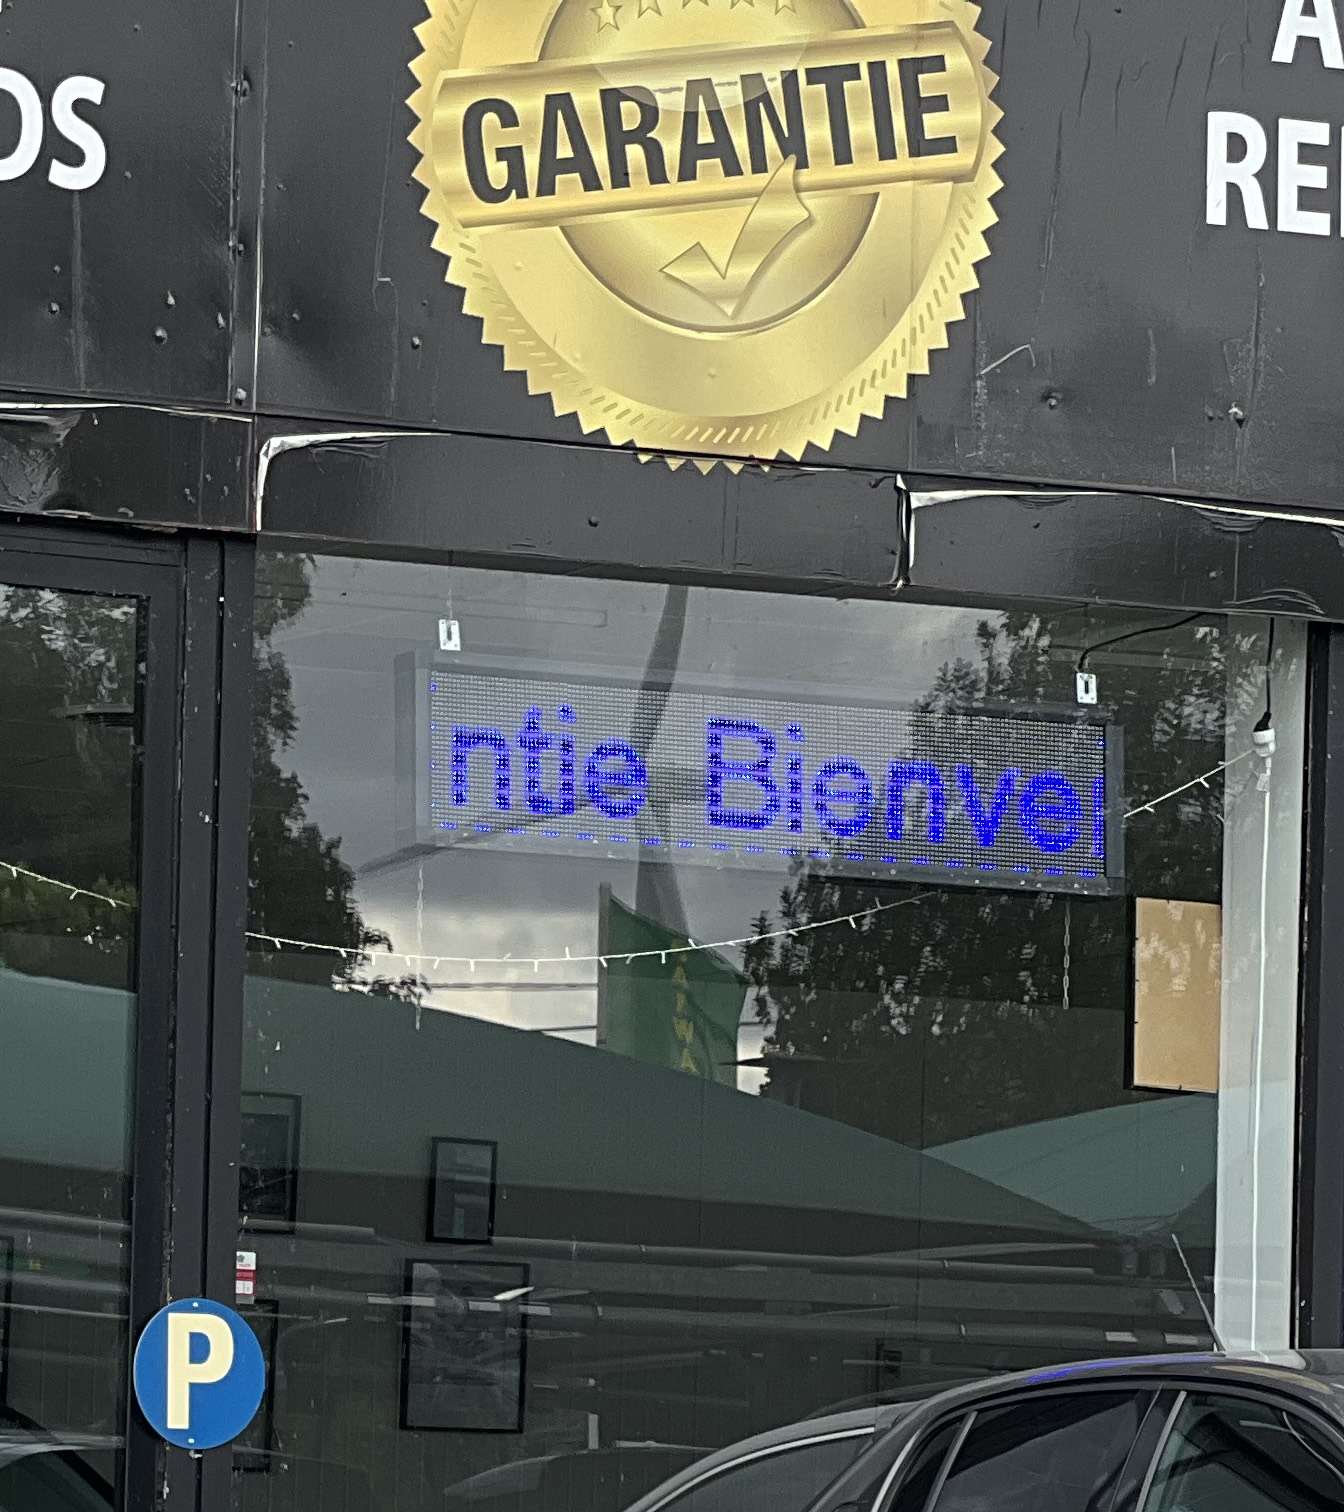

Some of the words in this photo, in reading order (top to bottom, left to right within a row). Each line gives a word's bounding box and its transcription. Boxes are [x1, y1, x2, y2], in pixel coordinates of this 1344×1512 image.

[461, 54, 959, 204] GARANTIE
[1206, 111, 1344, 238] RE
[451, 703, 648, 819] ntie
[706, 715, 1104, 857] Bienve
[167, 1312, 235, 1430] P
